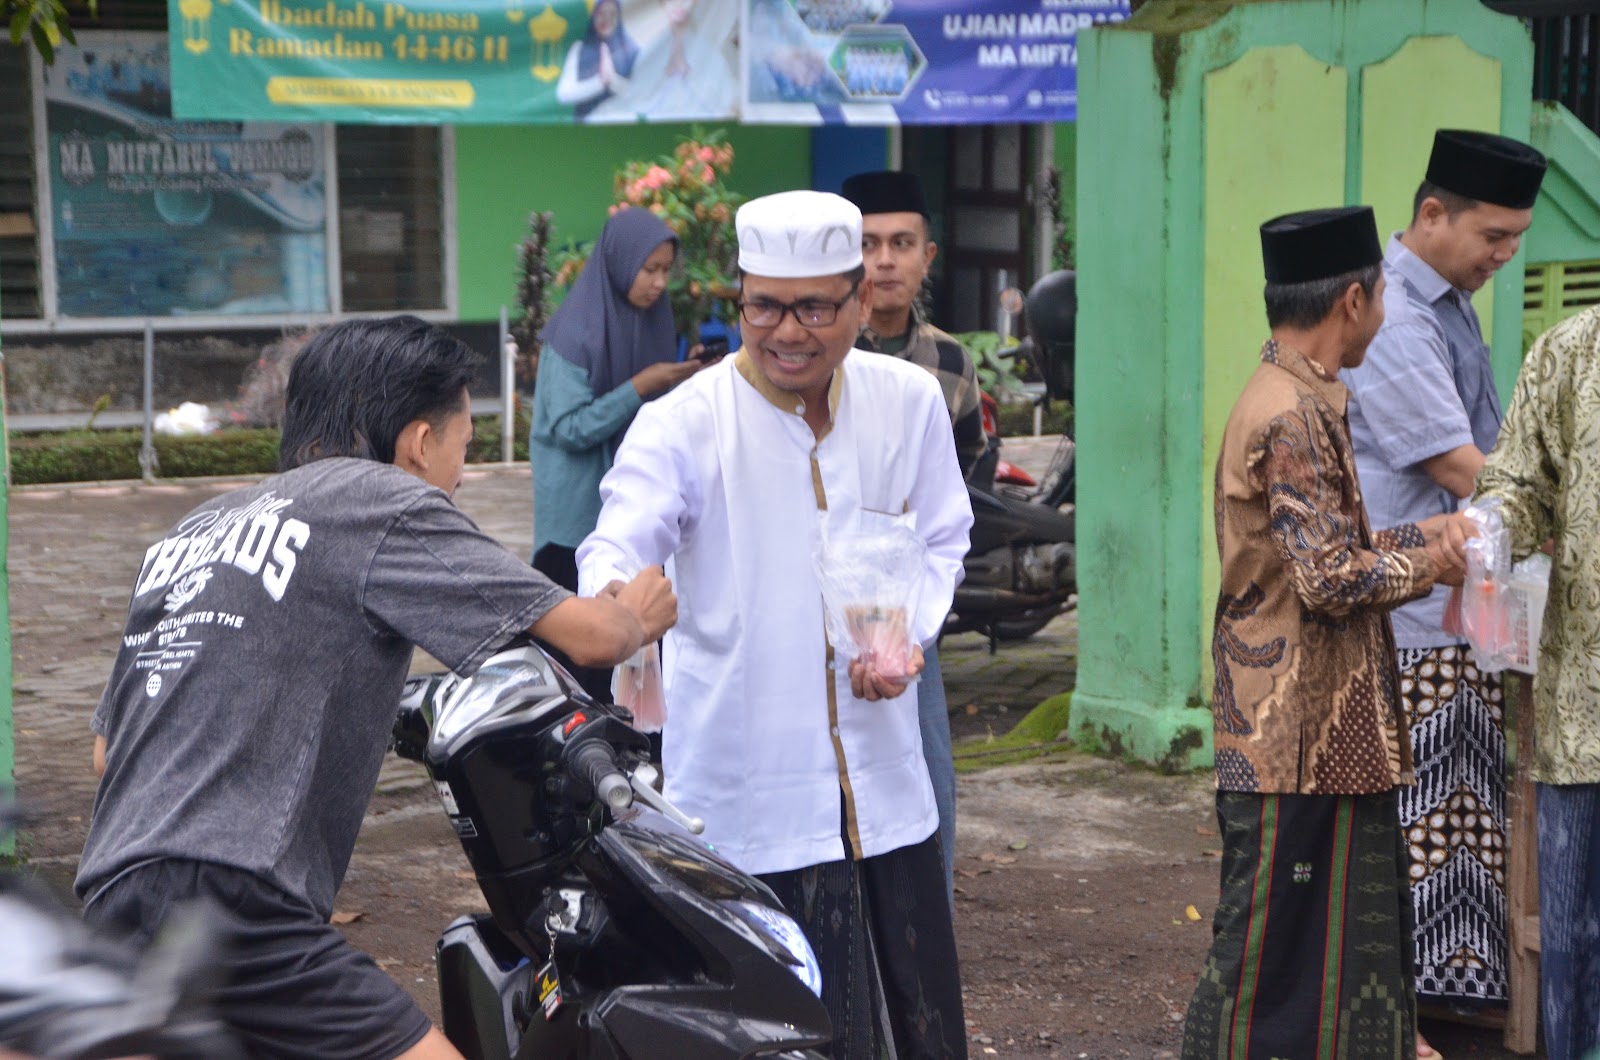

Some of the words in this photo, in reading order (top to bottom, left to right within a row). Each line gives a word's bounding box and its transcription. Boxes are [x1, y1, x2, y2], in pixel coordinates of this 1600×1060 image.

[259, 0, 375, 28] Ibadah
[384, 1, 479, 31] Puasa
[943, 14, 1016, 39] UJIAN
[229, 27, 383, 59] Ramadan
[393, 33, 475, 62] 1446
[978, 44, 1017, 66] MA
[60, 141, 95, 173] MA
[107, 140, 217, 173] MIFTAHUL
[153, 616, 181, 633] OUTH
[217, 611, 245, 629] THE
